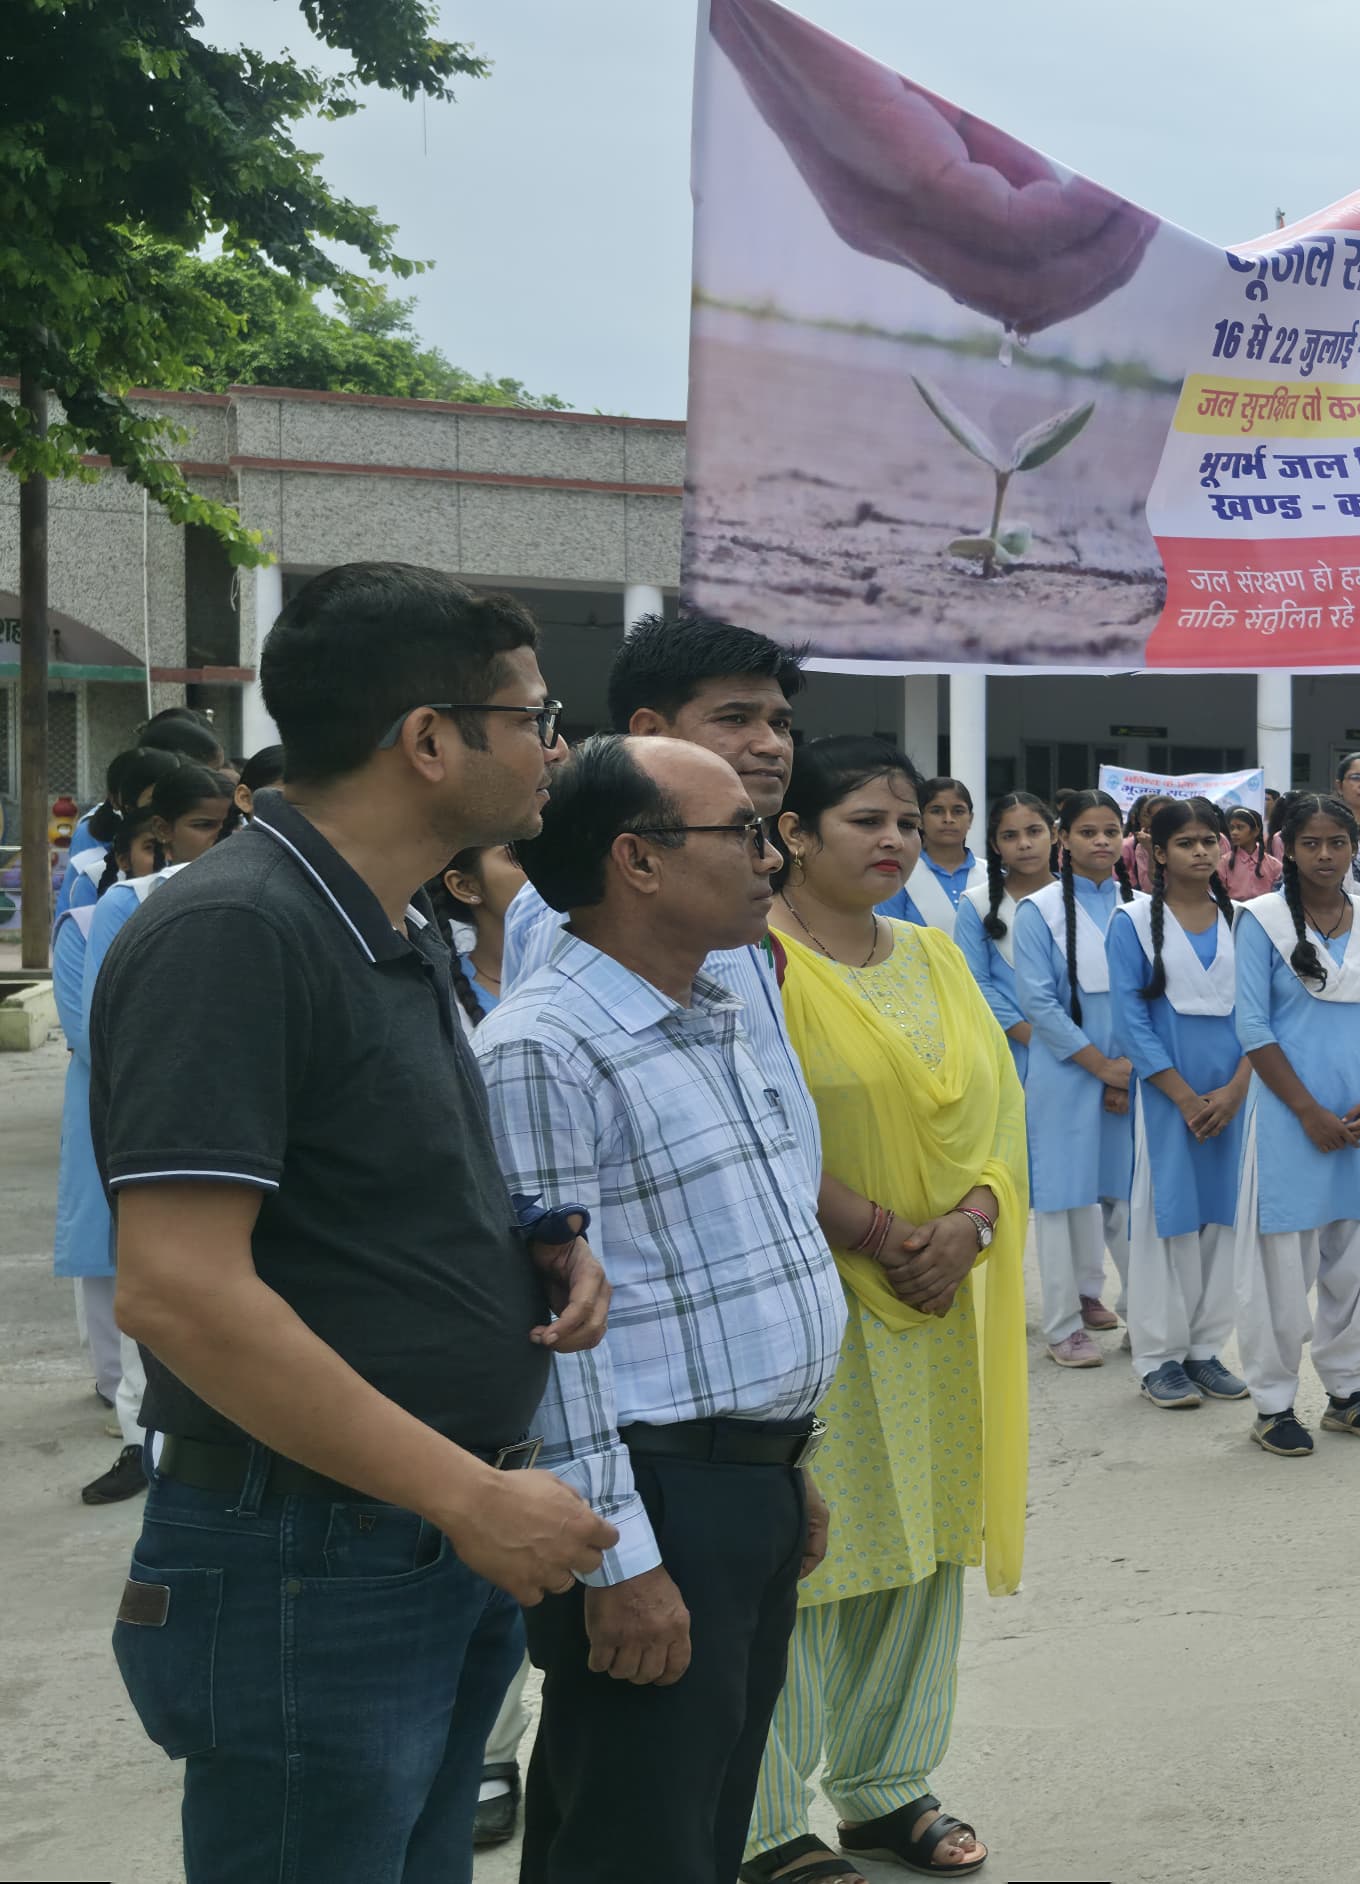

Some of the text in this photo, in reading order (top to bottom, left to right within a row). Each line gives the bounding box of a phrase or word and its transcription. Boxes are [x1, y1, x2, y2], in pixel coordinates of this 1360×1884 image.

[1212, 319, 1243, 358] 16
[1246, 314, 1271, 360] से
[1271, 327, 1298, 364] 22
[1300, 320, 1359, 376] जुलाई
[1197, 388, 1239, 419] जल
[1241, 386, 1299, 432] सुरक्षित
[1301, 388, 1323, 421] तो
[1199, 445, 1267, 487] भूगर्भ
[1273, 452, 1348, 479] जल
[1208, 494, 1302, 520] खण्ड
[1187, 569, 1229, 593] जल
[1235, 564, 1305, 593] संरक्षण
[1310, 560, 1333, 593] हो
[1177, 602, 1237, 629] ताकि
[1245, 599, 1322, 635] संतुलित
[1329, 602, 1355, 629] रहे
